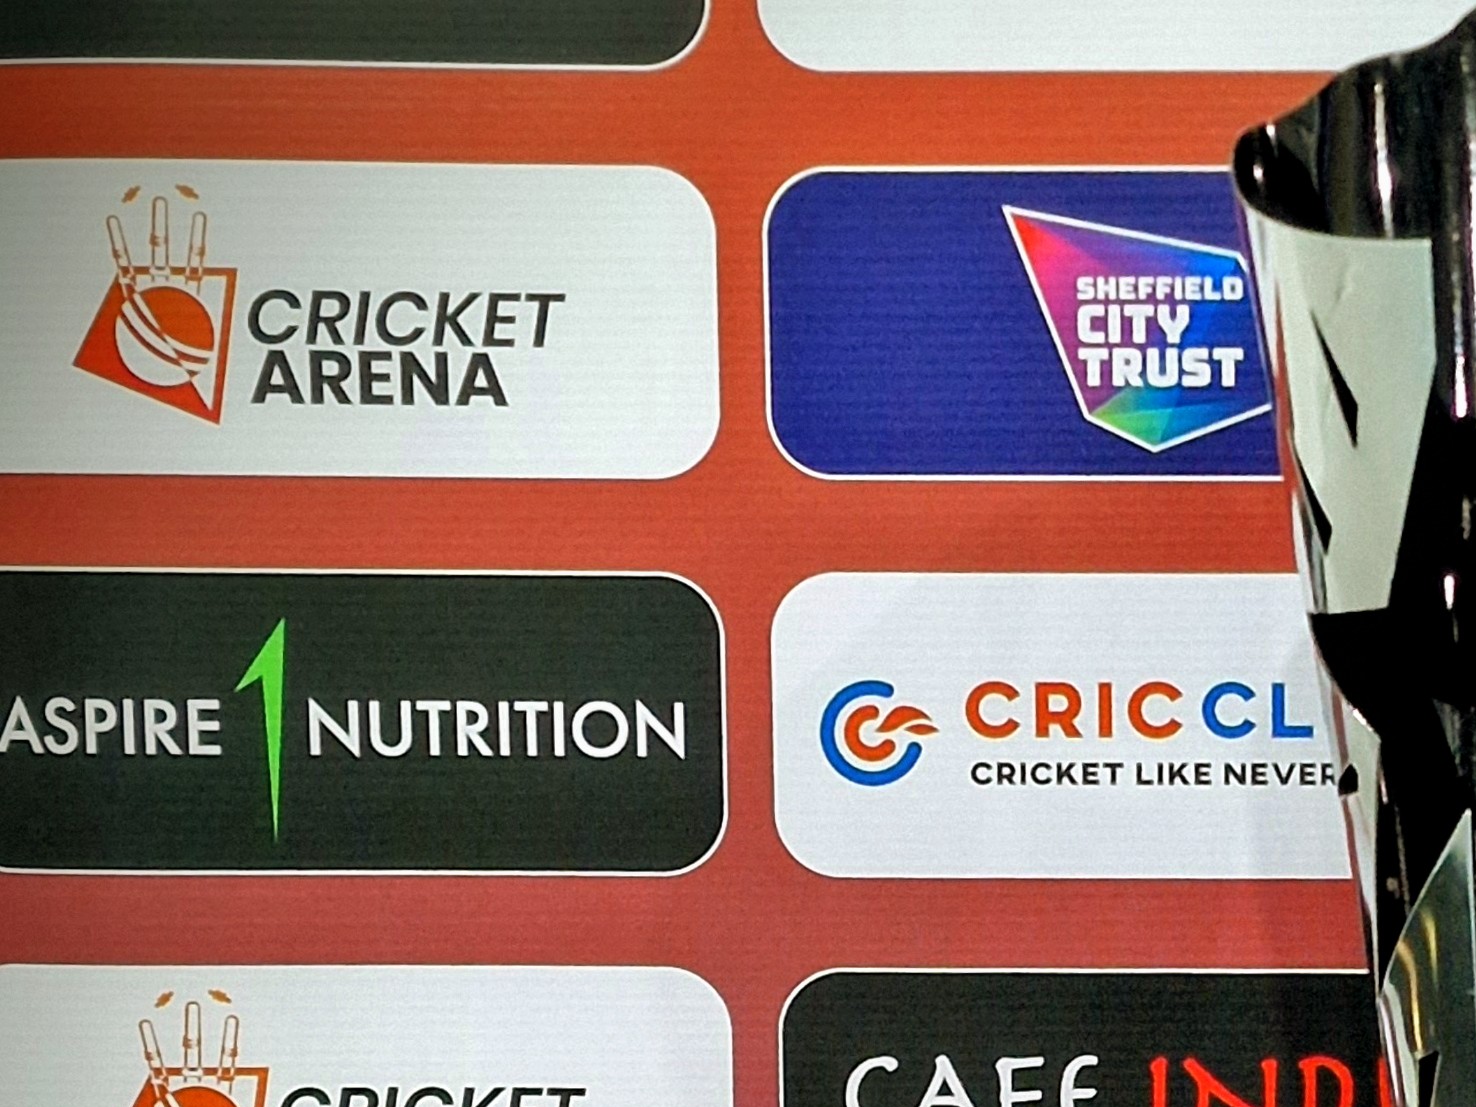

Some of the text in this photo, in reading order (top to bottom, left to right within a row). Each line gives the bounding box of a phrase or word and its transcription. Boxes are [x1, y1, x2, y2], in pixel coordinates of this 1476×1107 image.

[1076, 276, 1244, 301] SHEFFIELD
[247, 290, 566, 348] CRICKET
[1076, 305, 1190, 345] CITY
[250, 350, 509, 407] ARENA
[1076, 347, 1244, 388] TRUST
[0, 696, 222, 756] ASPIRE
[308, 699, 685, 759] NUTRITION
[970, 761, 1336, 786] CRICKET LIKE NEVER
